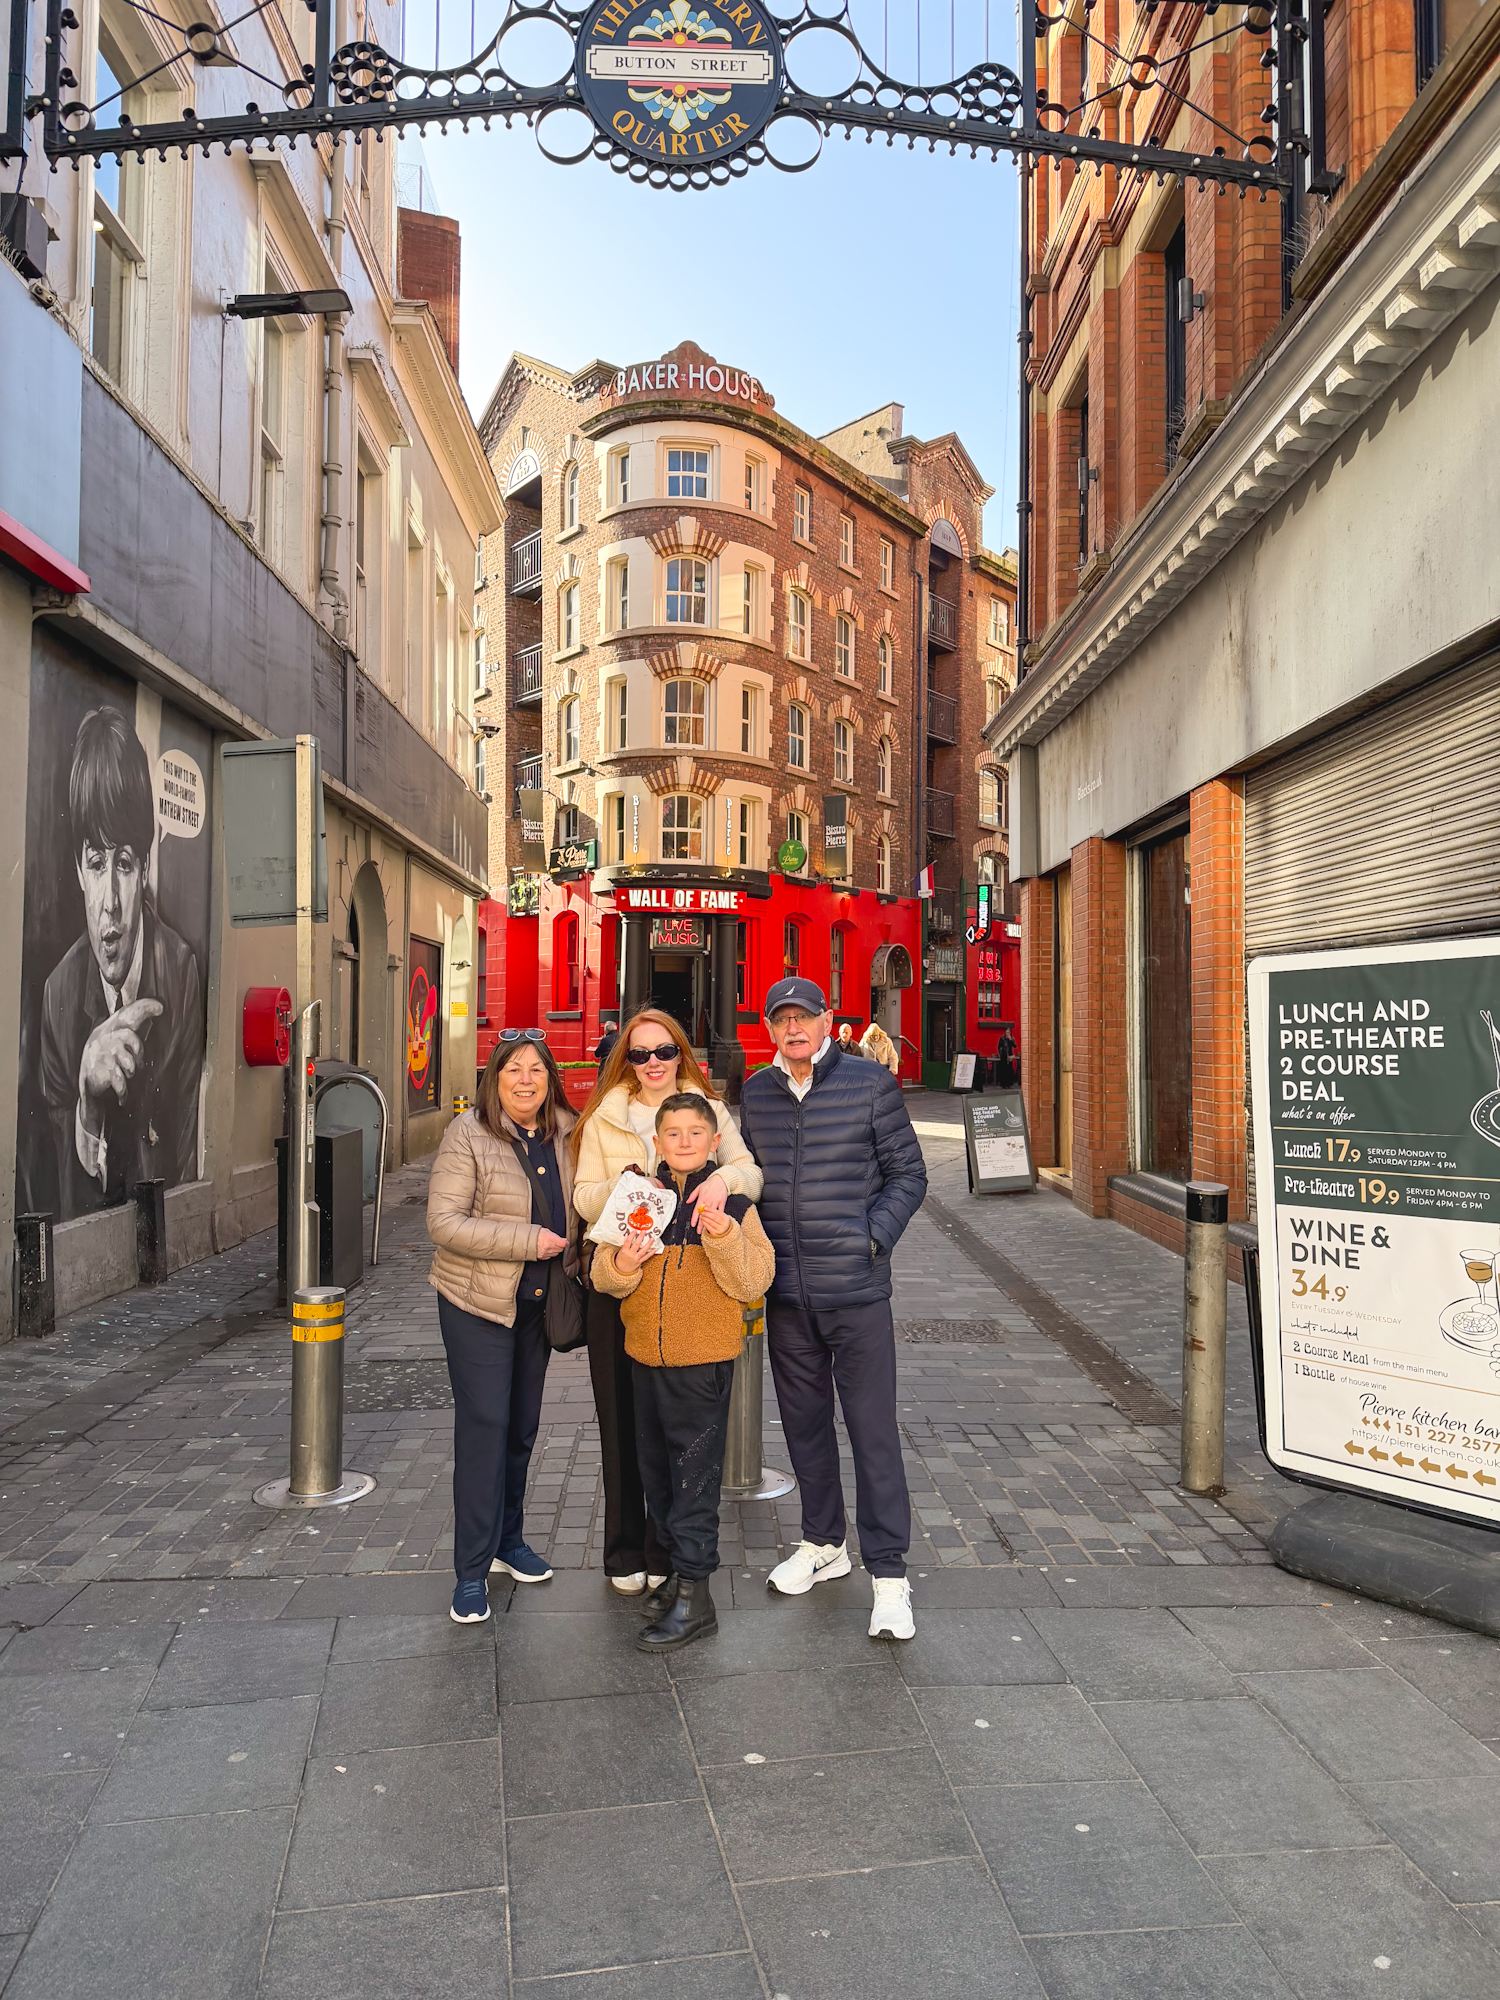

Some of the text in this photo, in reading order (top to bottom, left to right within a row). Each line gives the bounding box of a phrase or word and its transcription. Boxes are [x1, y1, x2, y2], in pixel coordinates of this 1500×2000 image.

[614, 56, 748, 72] BUTTON STREET
[612, 109, 750, 155] QUARTER
[617, 363, 758, 404] BAKER HOUSE
[163, 758, 197, 787] THIS WAY TO THE
[159, 796, 199, 828] MATHEW STREET
[825, 825, 846, 835] Bistro
[825, 836, 847, 846] Pierre
[628, 889, 738, 909] WALL OF FAME
[664, 919, 692, 931] LIVE
[658, 932, 699, 945] MUSIC
[1279, 999, 1430, 1024] LUNCH AND
[1280, 1026, 1445, 1049] PRE-THEATRE
[1280, 1054, 1400, 1075] 2 COURSE
[1282, 1081, 1345, 1102] DEAL
[1281, 1104, 1356, 1125] what's on offer
[1284, 1138, 1361, 1163] Lunch 17.9
[1367, 1147, 1396, 1156] SERVED
[1398, 1148, 1435, 1158] MONDAY
[1368, 1156, 1408, 1166] SATURDAY
[1409, 1159, 1430, 1167] 12PM
[1444, 1161, 1457, 1169] PM
[1284, 1175, 1400, 1205] Pre-theatre 19.9
[1406, 1187, 1490, 1200] SERVED MONDAY TO
[627, 1191, 664, 1215] FRESH
[1406, 1195, 1434, 1206] FRIDAY
[1435, 1199, 1454, 1208] 4PM
[1461, 1200, 1468, 1209] 6
[1469, 1201, 1483, 1209] PM
[1289, 1217, 1391, 1249] WINE &
[1291, 1242, 1361, 1270] DINE
[1291, 1301, 1312, 1311] EVERY
[1313, 1304, 1345, 1316] TUESDAY
[1354, 1311, 1402, 1325] WEDNESDAY
[1320, 1322, 1359, 1341] included
[1293, 1340, 1448, 1378] 2 Course Meal from the main menu
[1302, 1364, 1336, 1382] Bottle
[1340, 1376, 1348, 1384] of
[1348, 1377, 1370, 1388] house
[1371, 1382, 1387, 1391] wine
[1359, 1393, 1406, 1420] Pierre
[1411, 1406, 1468, 1434] kitchen
[1396, 1422, 1500, 1455] 151 227 2577
